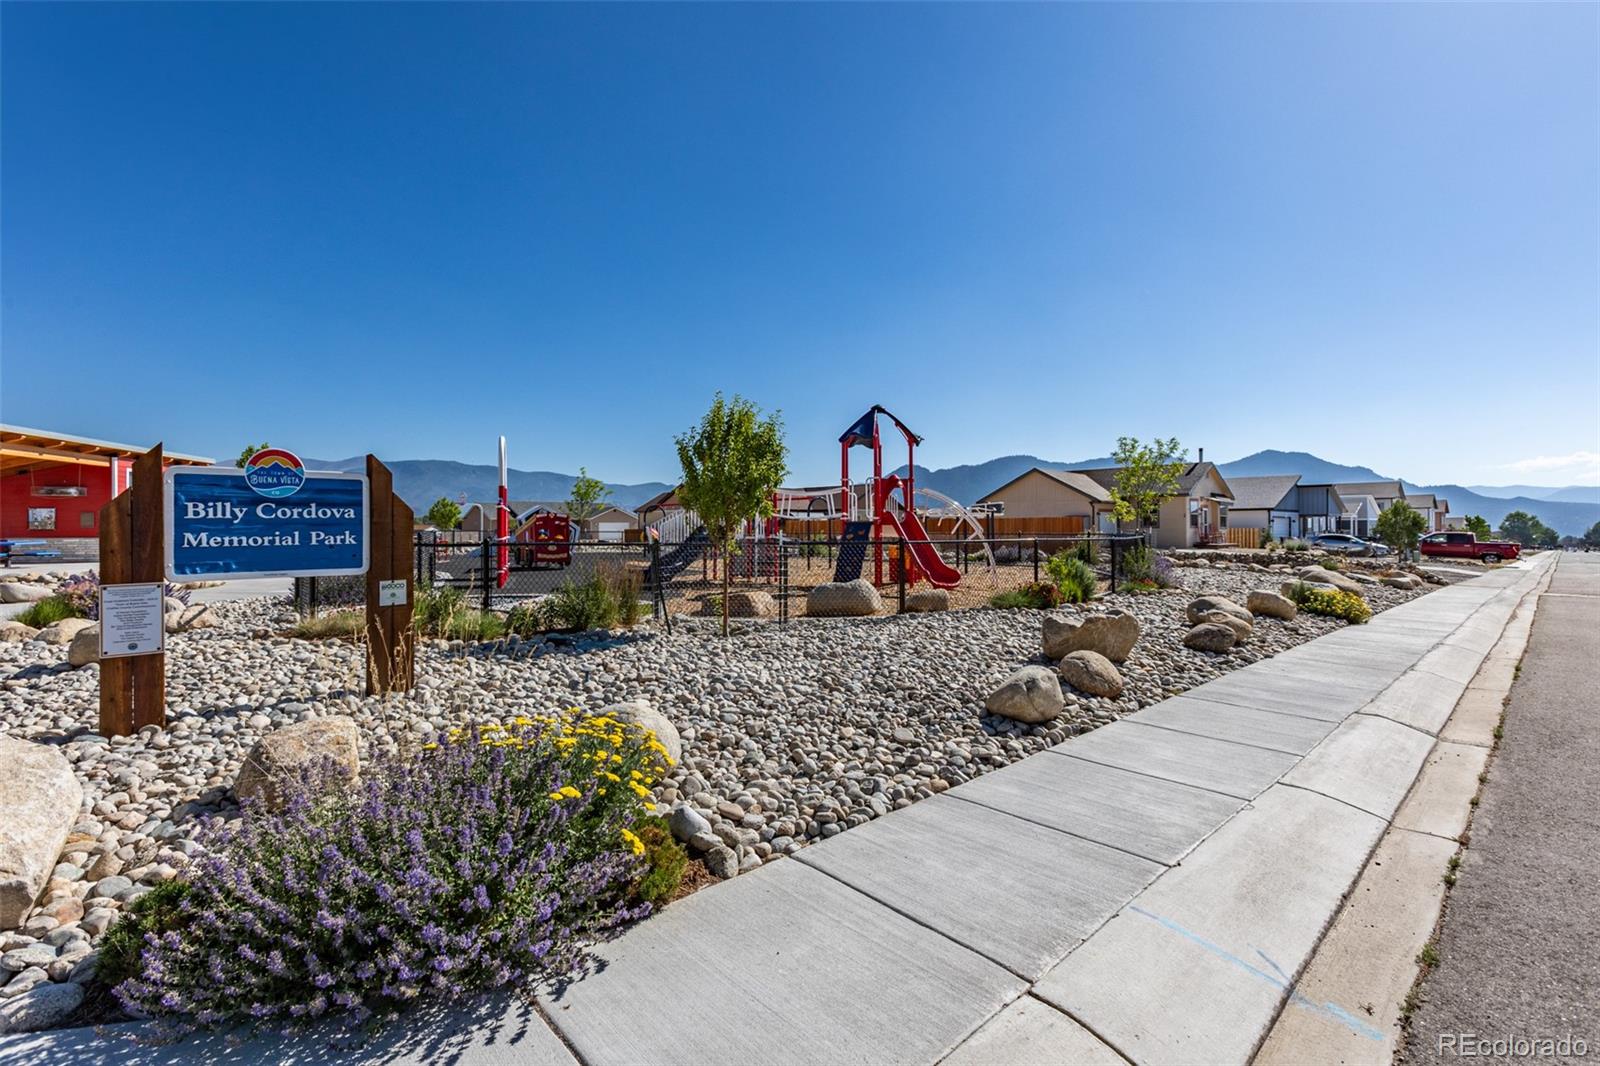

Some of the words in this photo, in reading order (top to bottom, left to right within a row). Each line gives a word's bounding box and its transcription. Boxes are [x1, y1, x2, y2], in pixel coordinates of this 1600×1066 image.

[250, 474, 278, 484] BUENA
[280, 475, 300, 484] VISTA
[184, 502, 248, 524] Billy
[256, 502, 356, 519] Cordova
[182, 532, 300, 548] Memorial
[310, 530, 357, 546] Park
